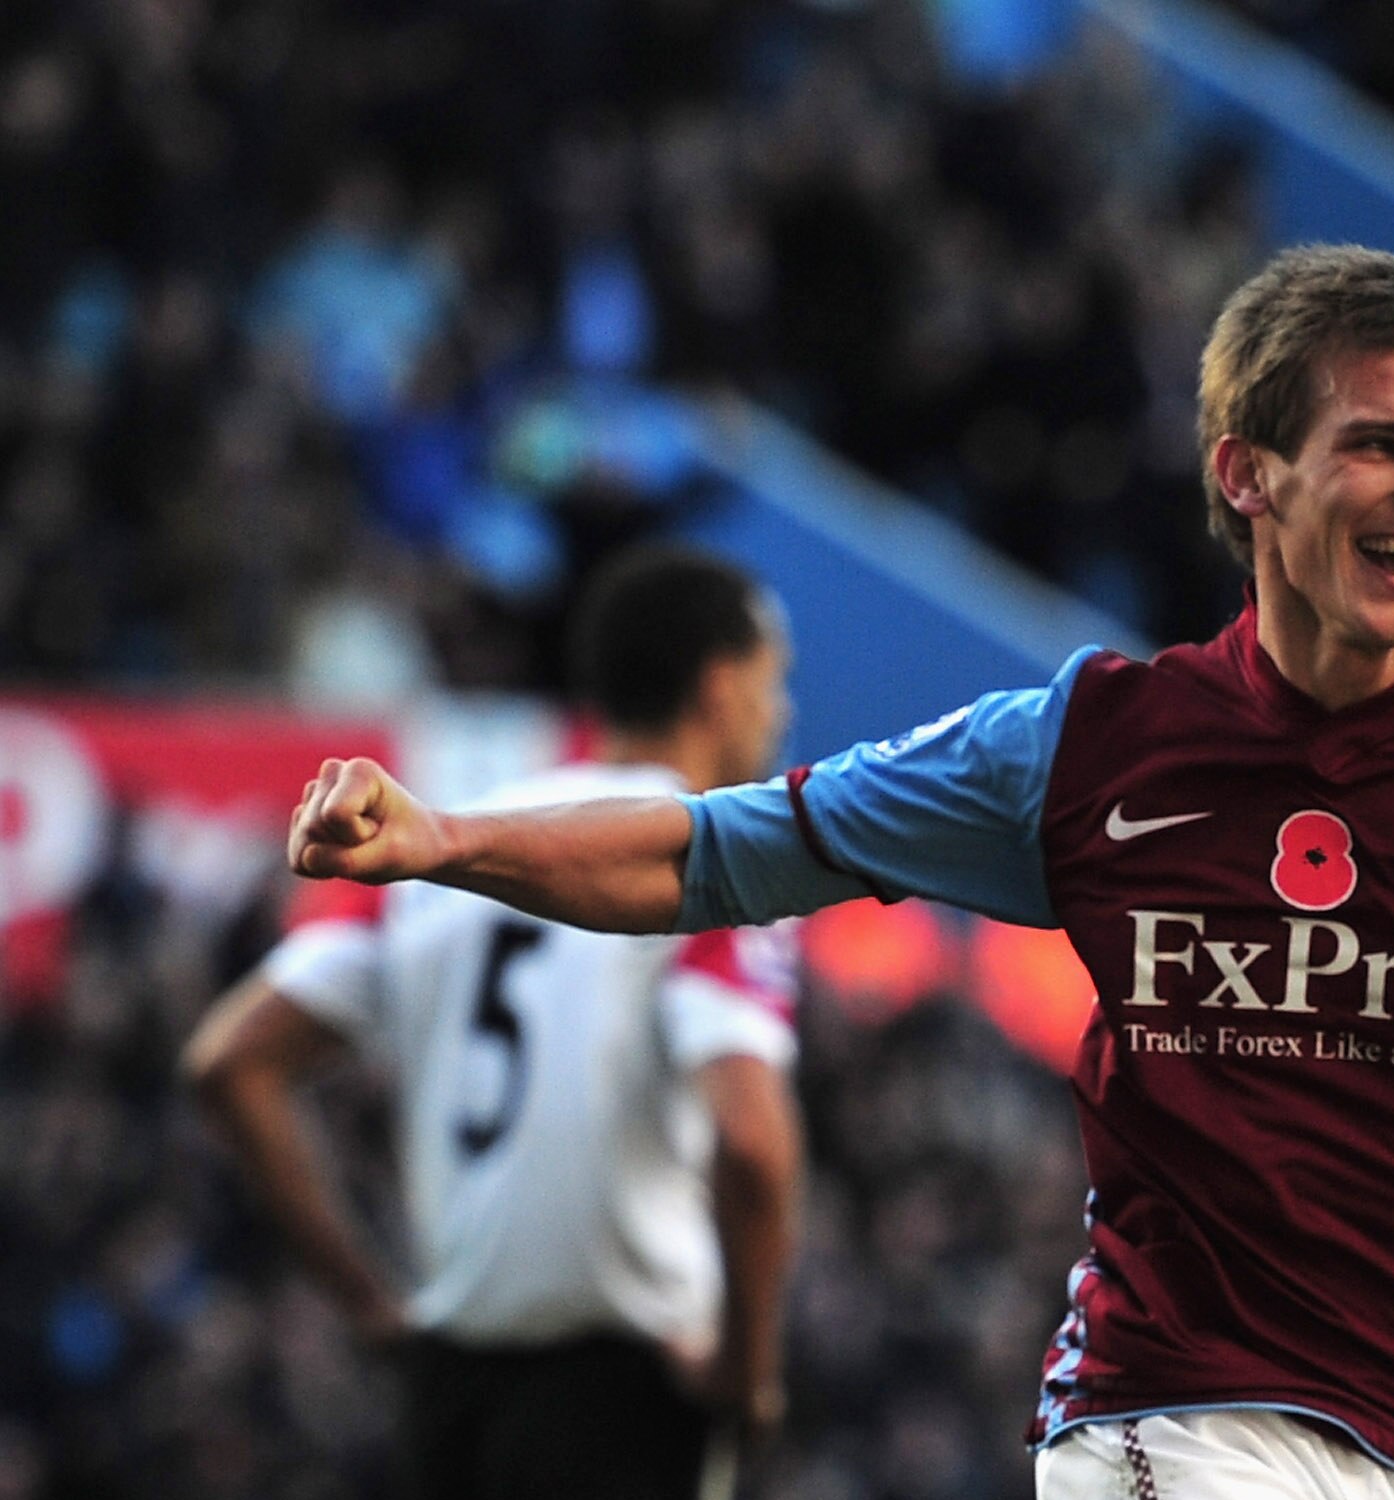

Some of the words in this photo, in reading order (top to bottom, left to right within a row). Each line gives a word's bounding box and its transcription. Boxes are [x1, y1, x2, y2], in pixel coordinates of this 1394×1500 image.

[455, 917, 547, 1158] 5
[1123, 1023, 1208, 1055] Trade
[1217, 1026, 1303, 1058] Forex
[1314, 1031, 1382, 1063] Like
